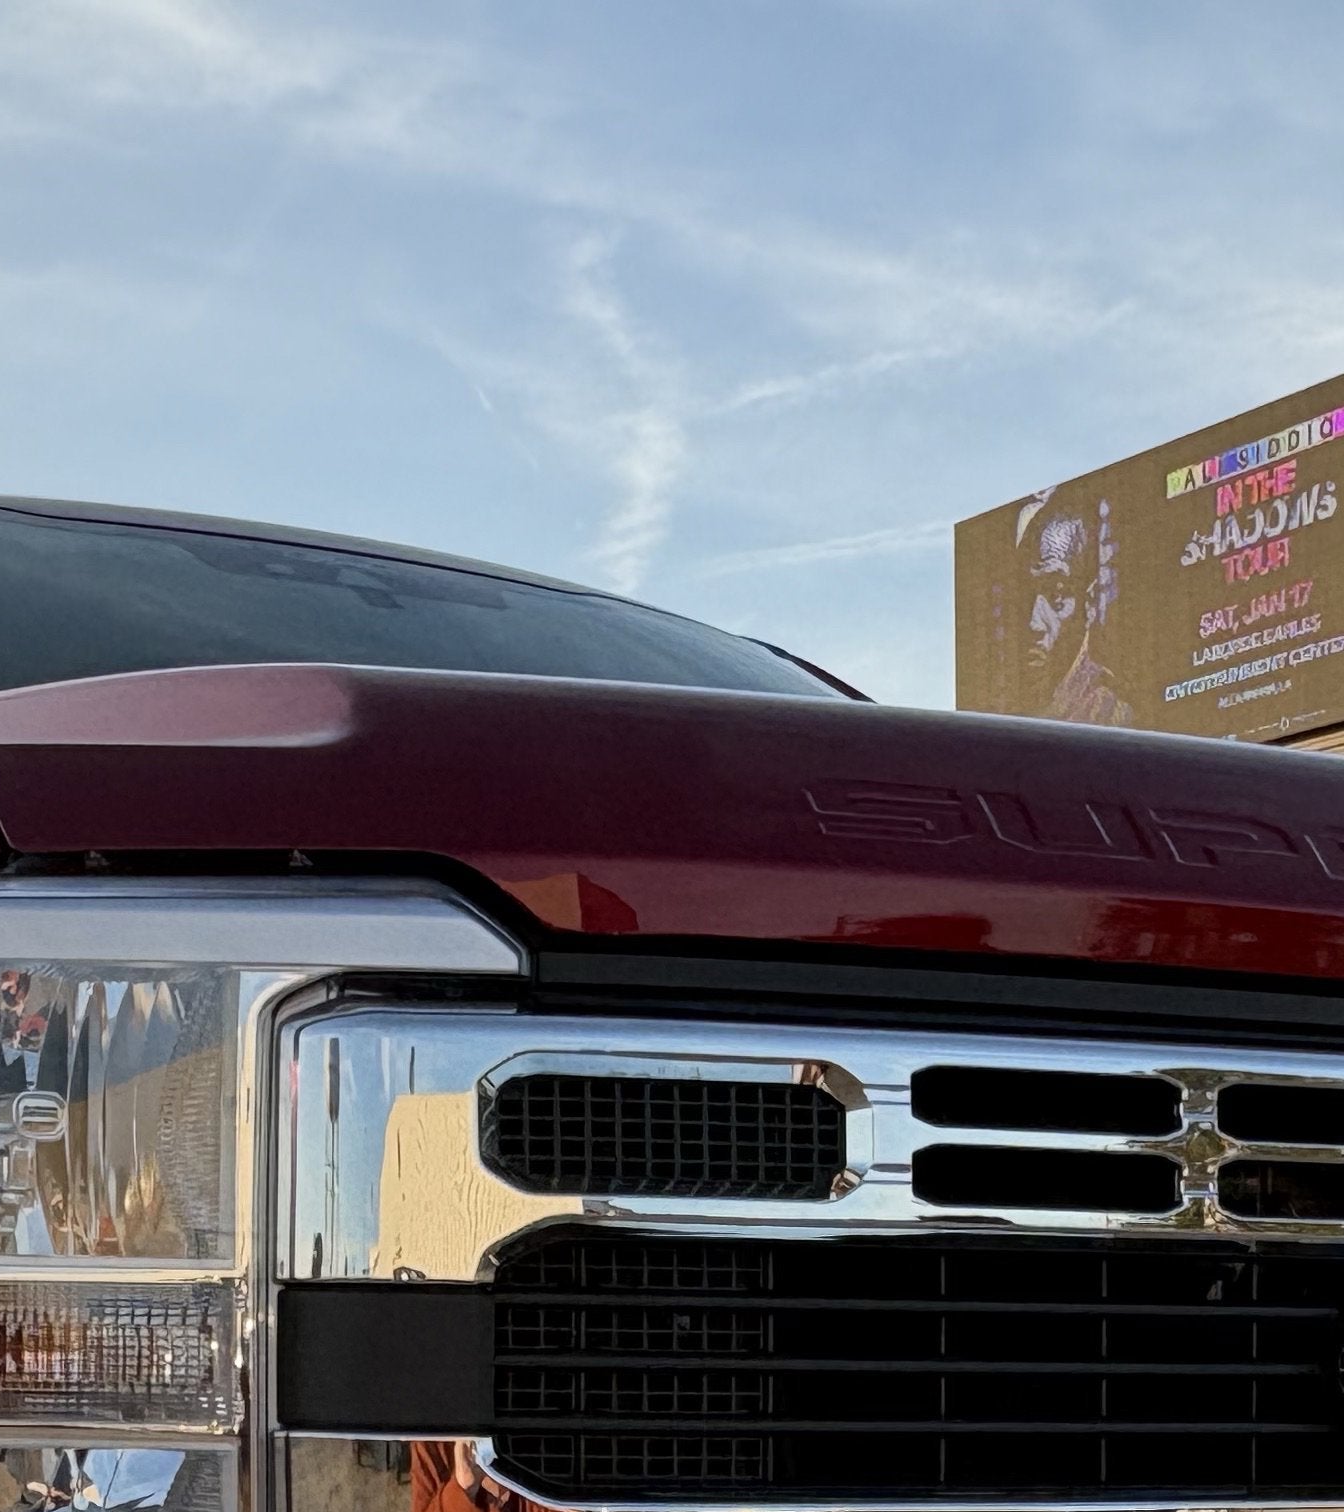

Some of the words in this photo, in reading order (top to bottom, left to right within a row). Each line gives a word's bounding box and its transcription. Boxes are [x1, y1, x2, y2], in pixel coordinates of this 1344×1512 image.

[1216, 479, 1243, 517] IN
[1244, 458, 1298, 505] THE
[1221, 537, 1291, 584] TOUR
[1242, 588, 1287, 626] JAN
[1288, 580, 1313, 609] 17
